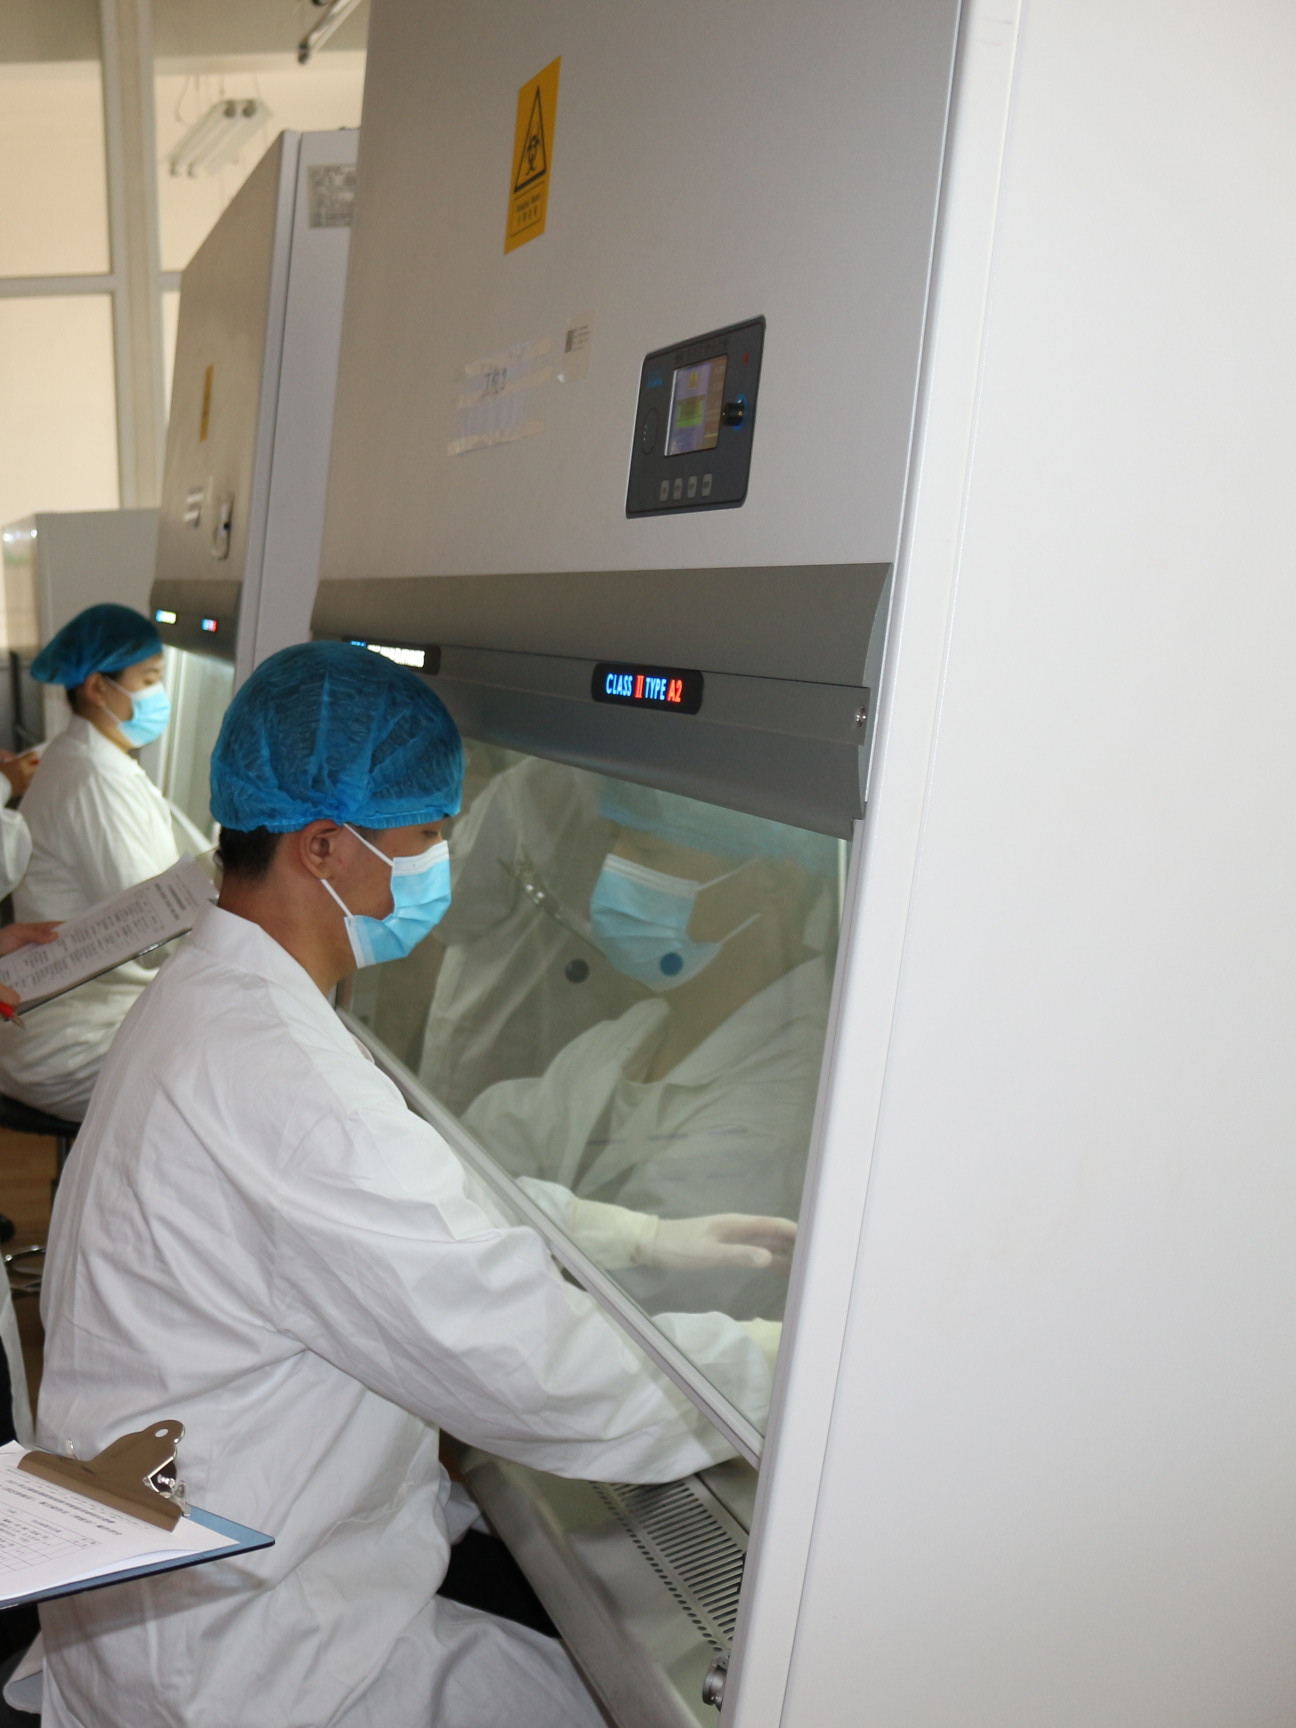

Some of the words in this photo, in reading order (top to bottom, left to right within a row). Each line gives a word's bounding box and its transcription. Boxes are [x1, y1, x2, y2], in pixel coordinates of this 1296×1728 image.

[606, 673, 633, 697] CLASS
[645, 677, 667, 700] TYPE
[667, 679, 683, 703] A2
